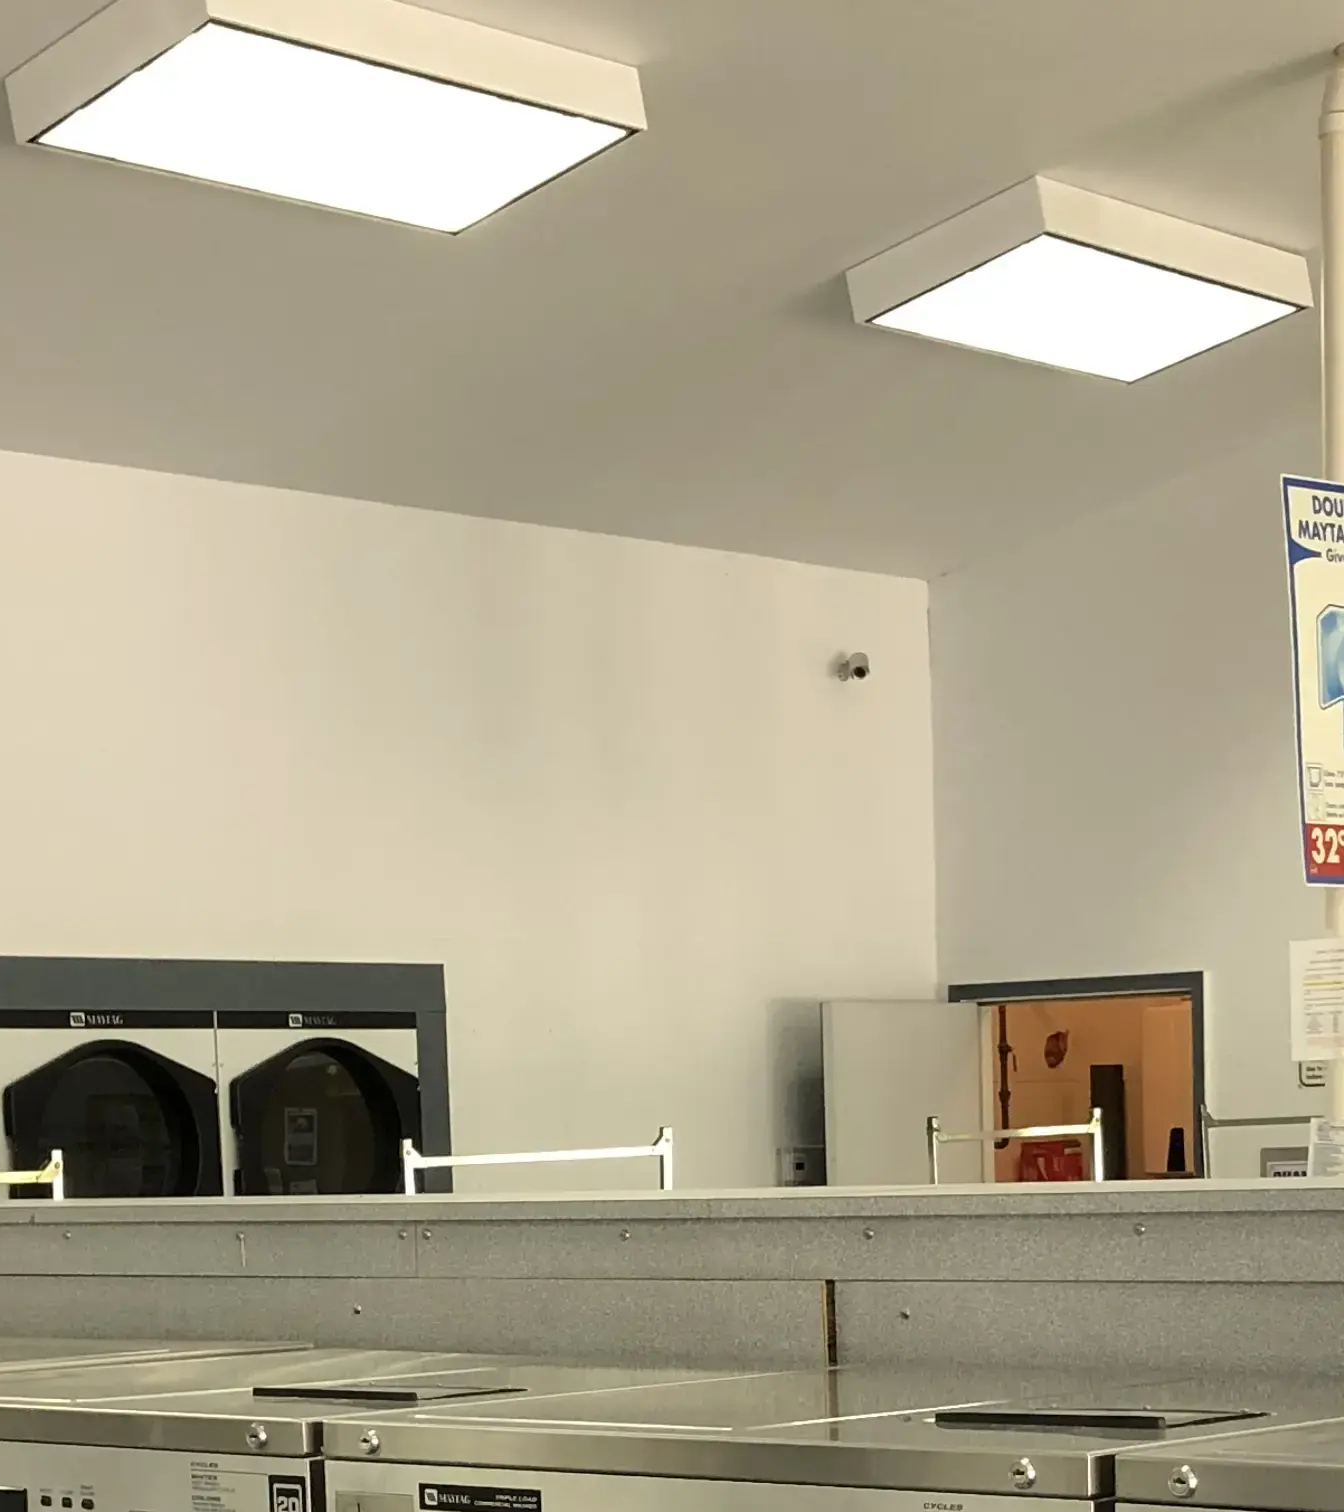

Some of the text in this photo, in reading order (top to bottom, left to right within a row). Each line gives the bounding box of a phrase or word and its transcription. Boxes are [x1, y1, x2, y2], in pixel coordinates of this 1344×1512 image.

[87, 1015, 123, 1024] MAYTAG
[439, 1494, 471, 1504] MAYTAG
[924, 1503, 963, 1511] CYCLES
